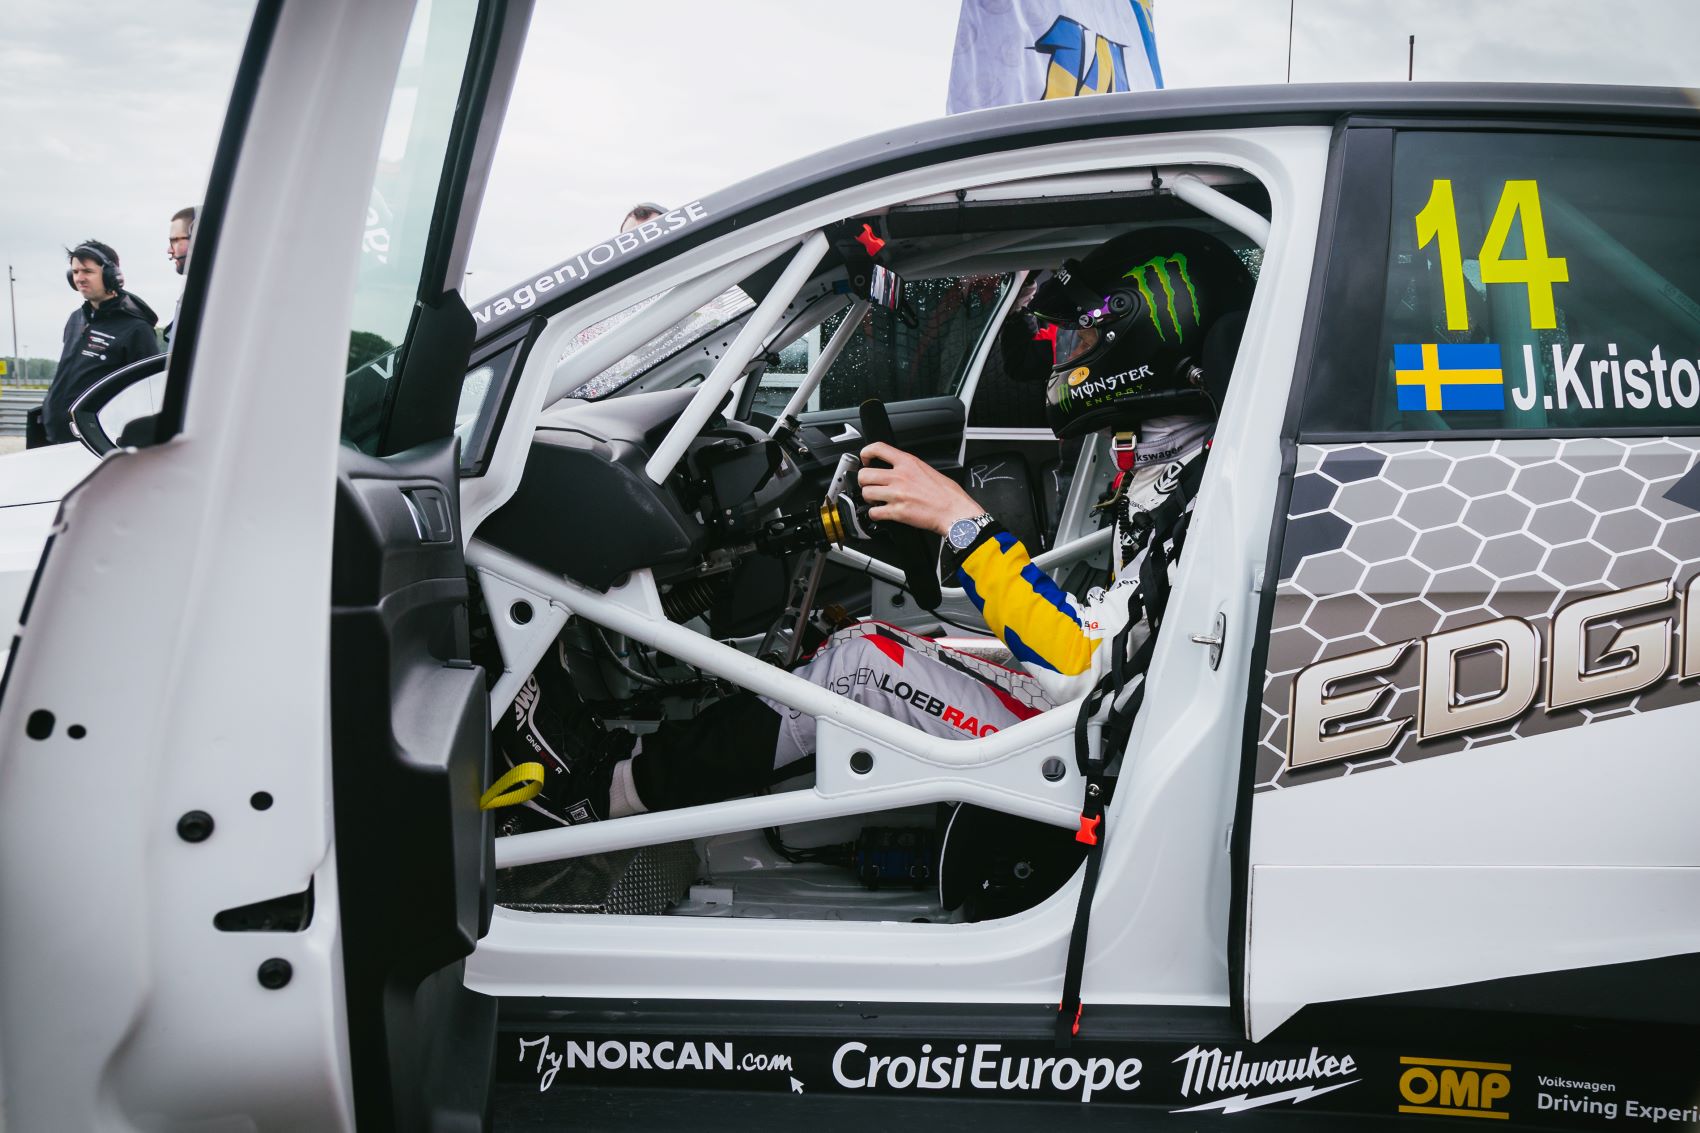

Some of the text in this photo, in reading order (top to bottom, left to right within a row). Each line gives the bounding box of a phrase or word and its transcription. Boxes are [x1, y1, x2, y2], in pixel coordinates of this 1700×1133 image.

[1415, 179, 1569, 331] 14
[1085, 384, 1143, 407] ENERGY
[1511, 343, 1700, 411] J.Kristo
[1285, 573, 1700, 774] EDG
[832, 1041, 1143, 1103] CroisiEurope
[1171, 1044, 1358, 1098] Milwaukee
[1399, 1066, 1511, 1109] OMP
[1537, 1075, 1616, 1092] Volkswagen
[1537, 1092, 1700, 1123] Driving Experi
